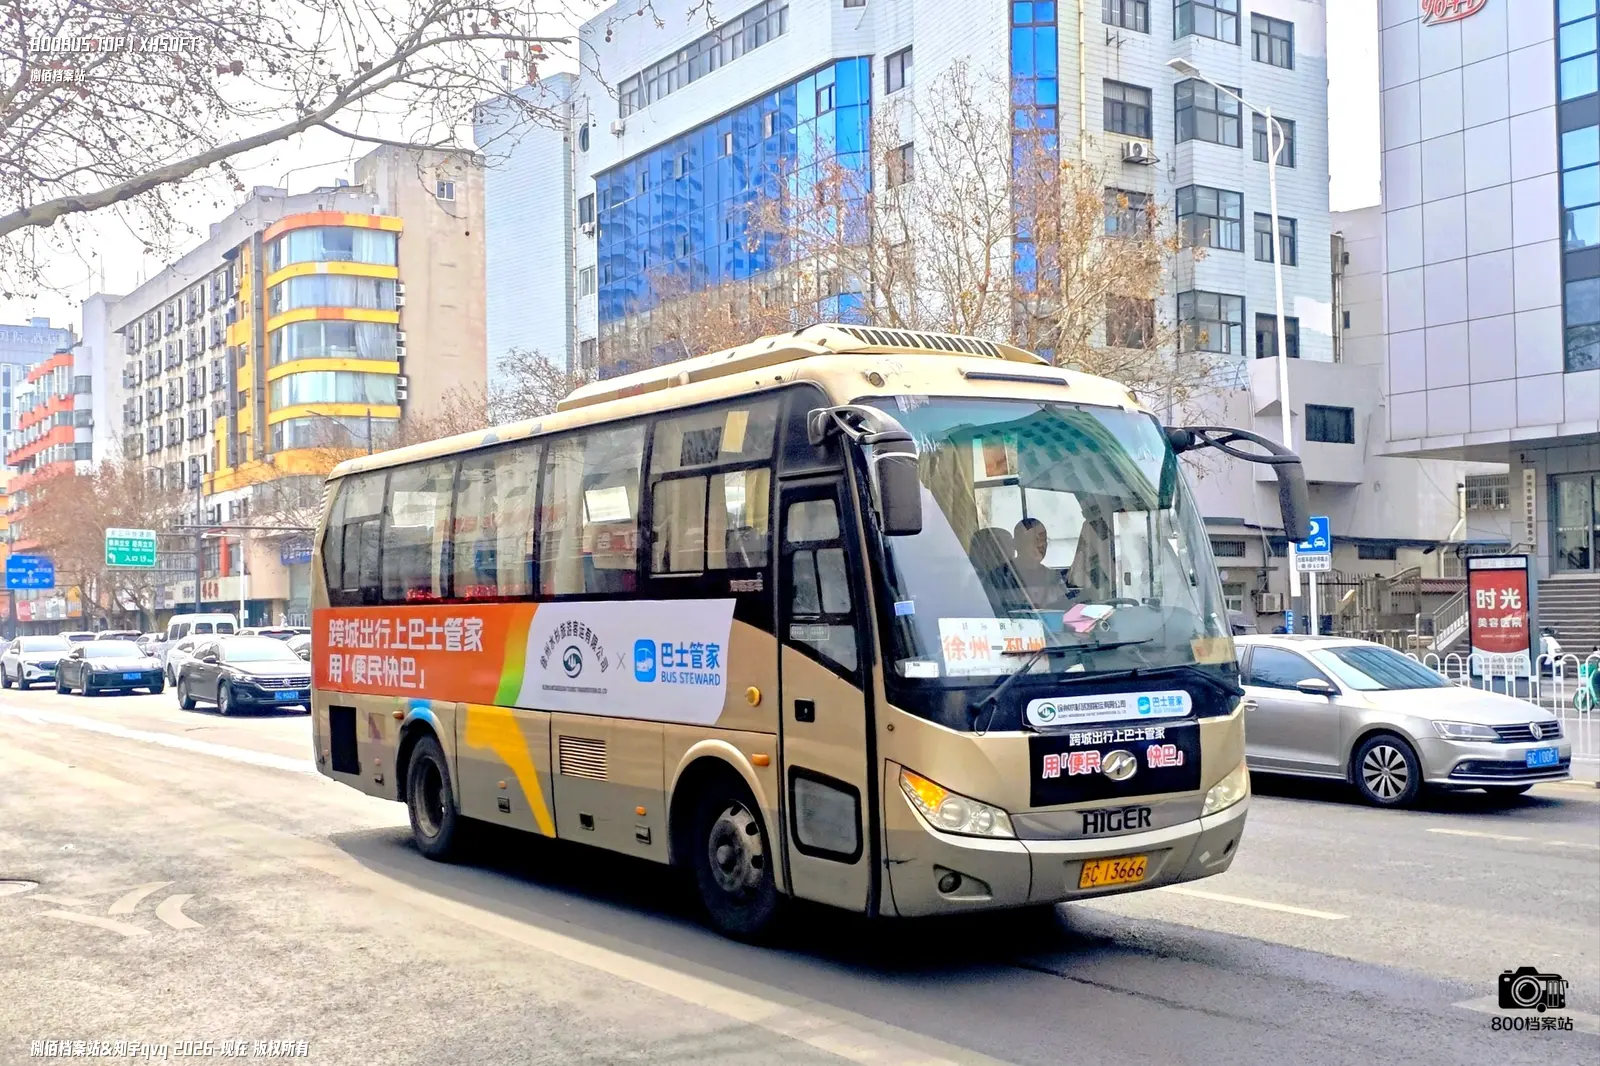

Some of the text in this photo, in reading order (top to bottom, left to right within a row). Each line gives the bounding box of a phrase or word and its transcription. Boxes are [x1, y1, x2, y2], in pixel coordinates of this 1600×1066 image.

[1475, 587, 1522, 610] 时光
[1477, 617, 1522, 628] 美容医院
[328, 617, 484, 652] 跨城出行上巴士管家
[661, 641, 720, 669] 巴士管家
[661, 671, 721, 686] BUS STEWARD
[1151, 695, 1184, 707] 巴士管家
[1069, 726, 1166, 747] 跨城出行上巴士管家
[1082, 807, 1152, 835] HIGER
